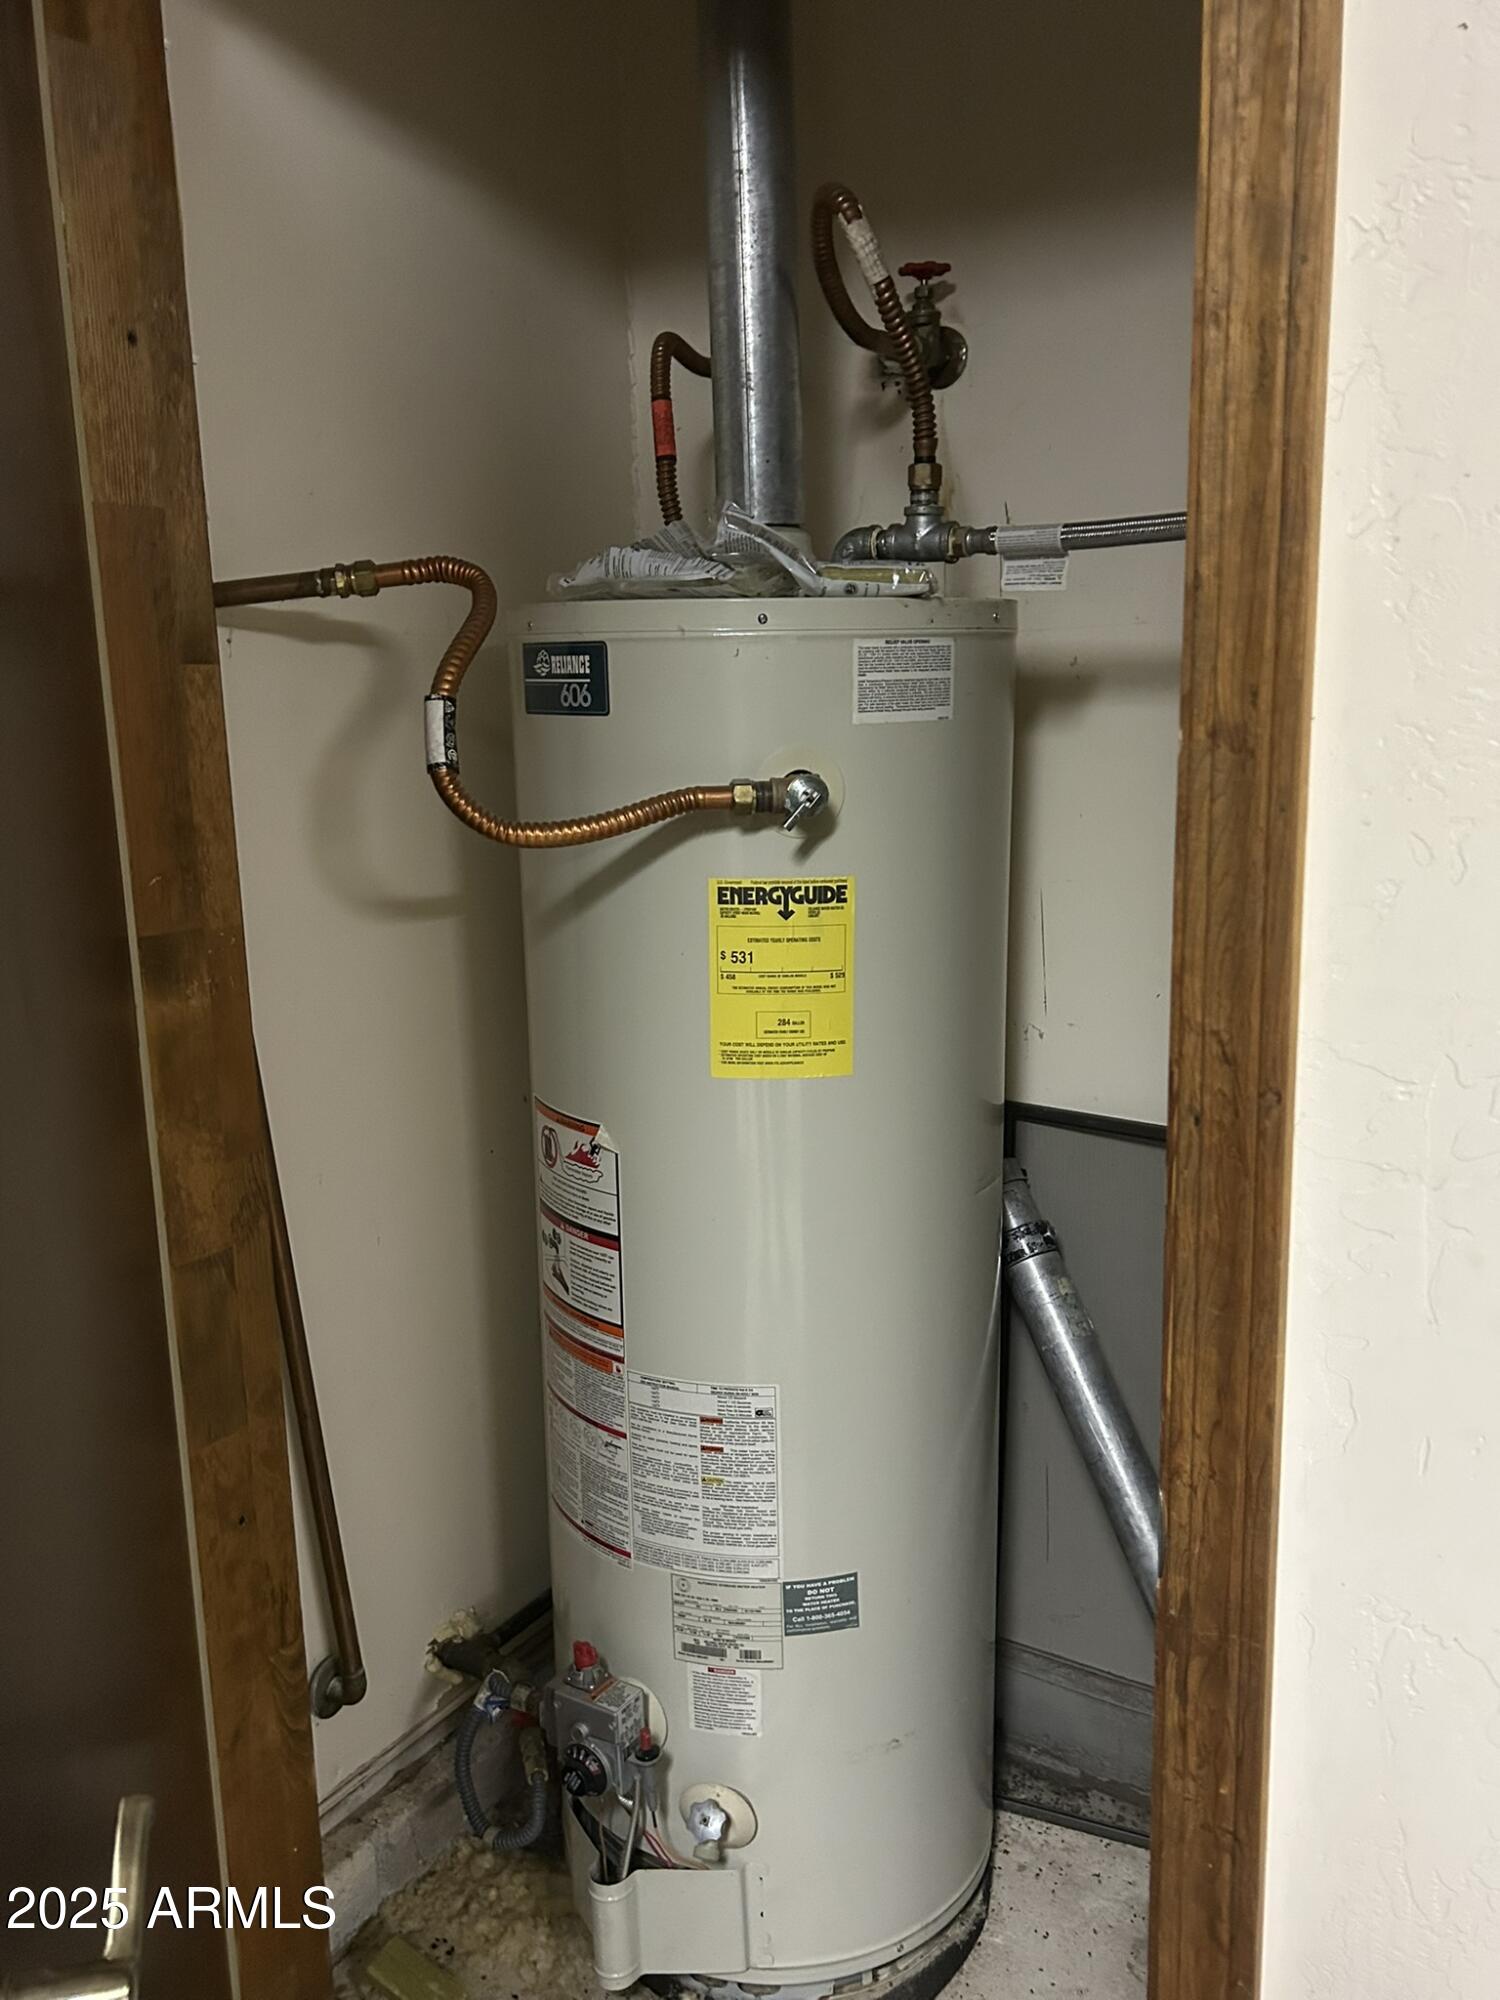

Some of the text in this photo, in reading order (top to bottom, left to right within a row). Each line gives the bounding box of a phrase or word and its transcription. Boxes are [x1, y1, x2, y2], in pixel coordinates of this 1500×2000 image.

[551, 655, 590, 674] RELIANCE
[560, 683, 592, 707] 606
[717, 885, 848, 912] ENERGYGUIDE
[720, 951, 753, 964] $ 531
[777, 1018, 791, 1026] 284
